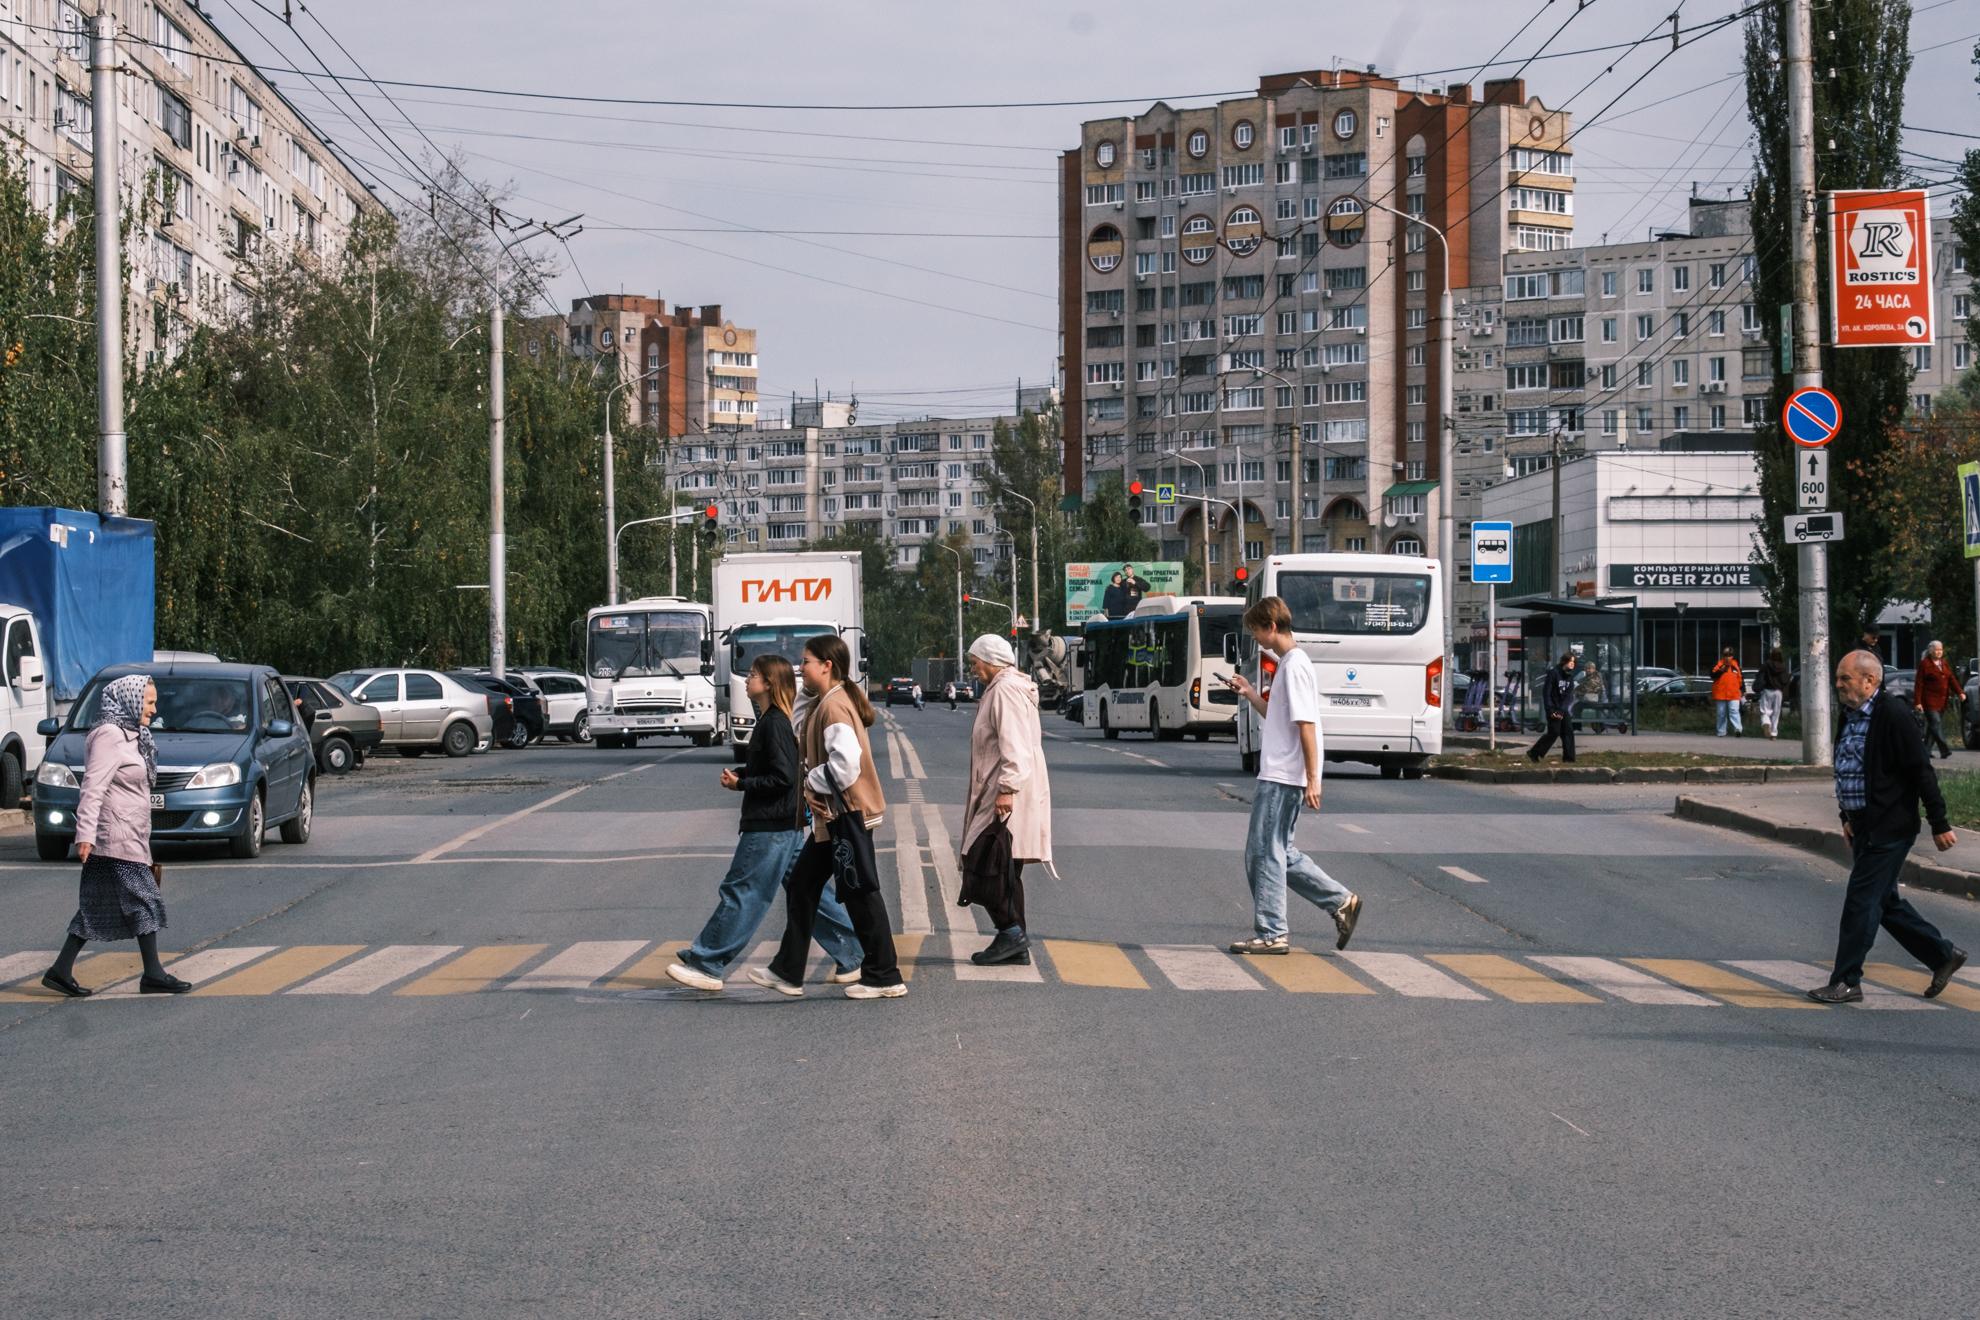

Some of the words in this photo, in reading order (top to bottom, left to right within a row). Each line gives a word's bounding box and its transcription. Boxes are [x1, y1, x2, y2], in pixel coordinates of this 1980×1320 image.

[1859, 222, 1904, 258] R
[1848, 271, 1917, 282] ROSTIC'S
[1855, 294, 1873, 310] 24
[1875, 293, 1912, 309] ЧАСА
[1801, 482, 1825, 494] 600
[1633, 565, 1721, 573] КОМПЬЮТЕРНЫЙ
[1633, 573, 1697, 586] CYBER
[1701, 573, 1751, 585] ZONE
